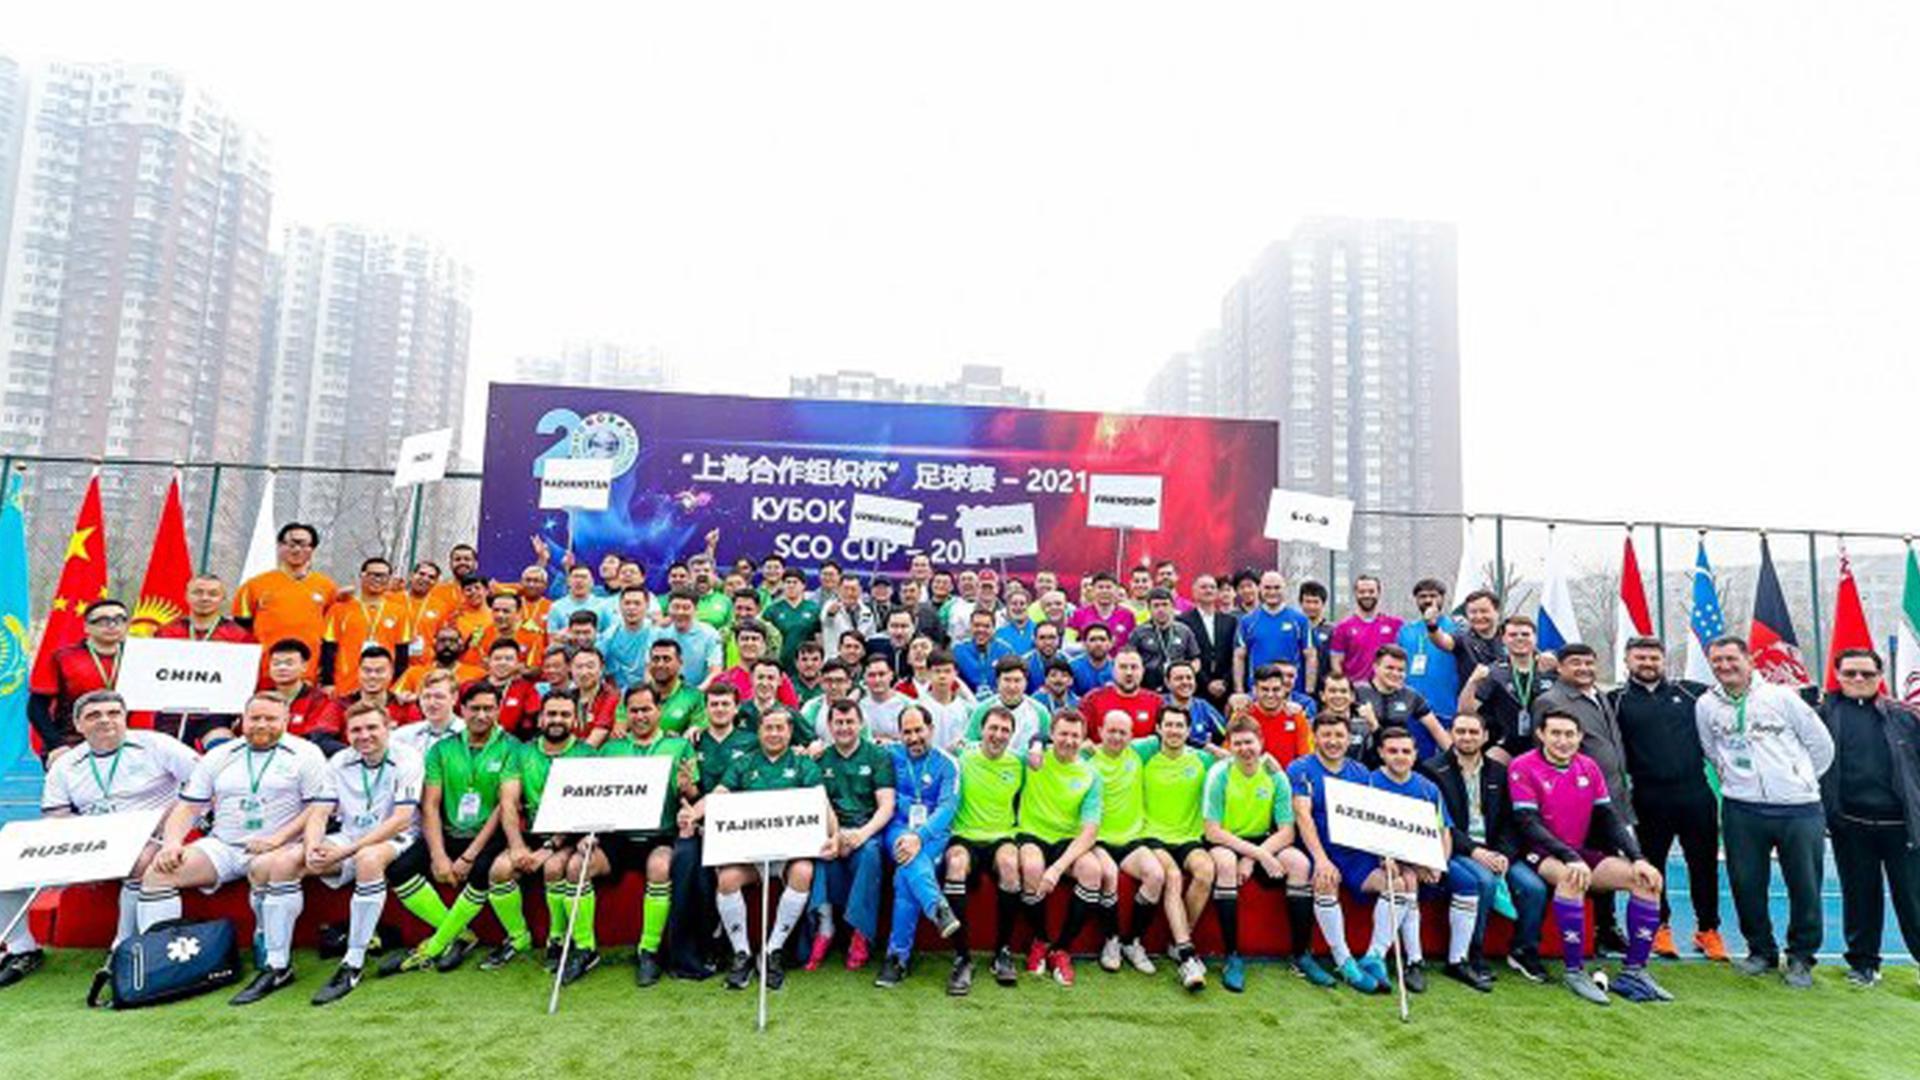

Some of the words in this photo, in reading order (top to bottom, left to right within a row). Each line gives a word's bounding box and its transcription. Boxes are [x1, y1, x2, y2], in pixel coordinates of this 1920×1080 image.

[1026, 468, 1086, 493] 2021
[752, 496, 845, 524] КУБОК
[1094, 495, 1156, 506] FRIENDSHIP
[975, 525, 1023, 537] BELARUS
[774, 533, 832, 560] SCO
[842, 537, 897, 562] CUP
[931, 539, 992, 565] 20
[156, 668, 222, 683] CHINA
[562, 783, 648, 798] PAKISTAN
[715, 814, 820, 833] TAJIKISTAN
[1335, 803, 1438, 839] AZERBAIJAN
[19, 840, 108, 859] RUSSIA
